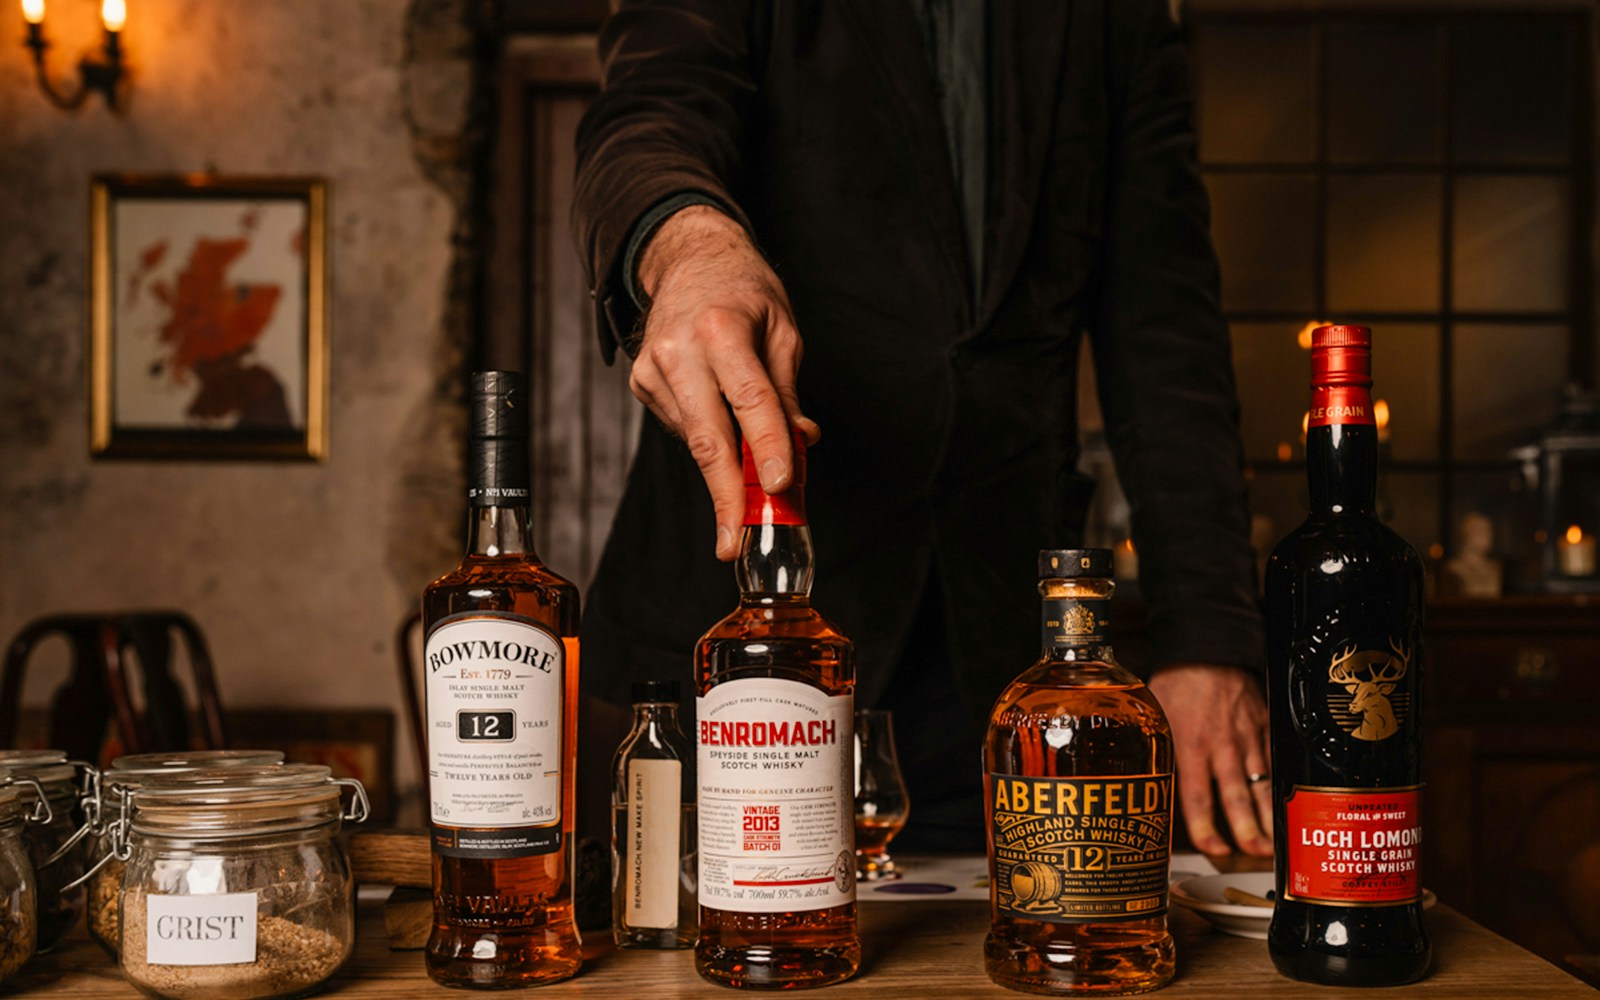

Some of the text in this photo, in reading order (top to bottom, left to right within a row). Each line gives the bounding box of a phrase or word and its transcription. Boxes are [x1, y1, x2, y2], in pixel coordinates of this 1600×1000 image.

[1326, 405, 1364, 418] GRAIN
[429, 640, 555, 674] BOWMORE
[486, 669, 512, 680] 1779
[454, 692, 520, 700] SCOTCH WHISKY
[793, 702, 819, 716] MATURED
[472, 715, 500, 737] 12
[522, 720, 549, 729] YEARS
[701, 719, 836, 748] BENROMACH
[710, 750, 820, 760] SPEYSIDE SINGLE MALT
[721, 761, 804, 770] SCOTCH WHISKY
[444, 771, 533, 781] TWELVE YEARS OLD
[636, 773, 644, 801] SPIRIT
[722, 787, 741, 795] HAND
[795, 785, 834, 794] CHARACTER
[995, 779, 1170, 815] ABERFELDY
[743, 805, 780, 815] VINTAGE
[1348, 803, 1399, 811] UNPEATED
[1337, 812, 1370, 821] FLORAL
[1383, 811, 1406, 820] SWEET
[743, 816, 780, 831] 2013
[1005, 816, 1075, 843] HIGHLAND
[1081, 816, 1136, 832] SINGLE
[1138, 824, 1163, 843] MALT
[635, 831, 643, 851] NEW
[1026, 829, 1085, 848] SCOTCH
[1090, 829, 1144, 848] WHISKY
[1302, 827, 1353, 848] LOCH
[744, 842, 781, 851] BATCH 01
[998, 850, 1058, 864] GUARANTEED
[1069, 847, 1104, 871] 12
[1116, 854, 1144, 863] YEARS
[1328, 848, 1412, 861] SINGLE GRAIN
[1321, 860, 1416, 873] SCOTCH WHISKY
[749, 889, 775, 899] 700ml
[778, 888, 803, 899] 59.7%
[157, 915, 244, 941] CRIST
